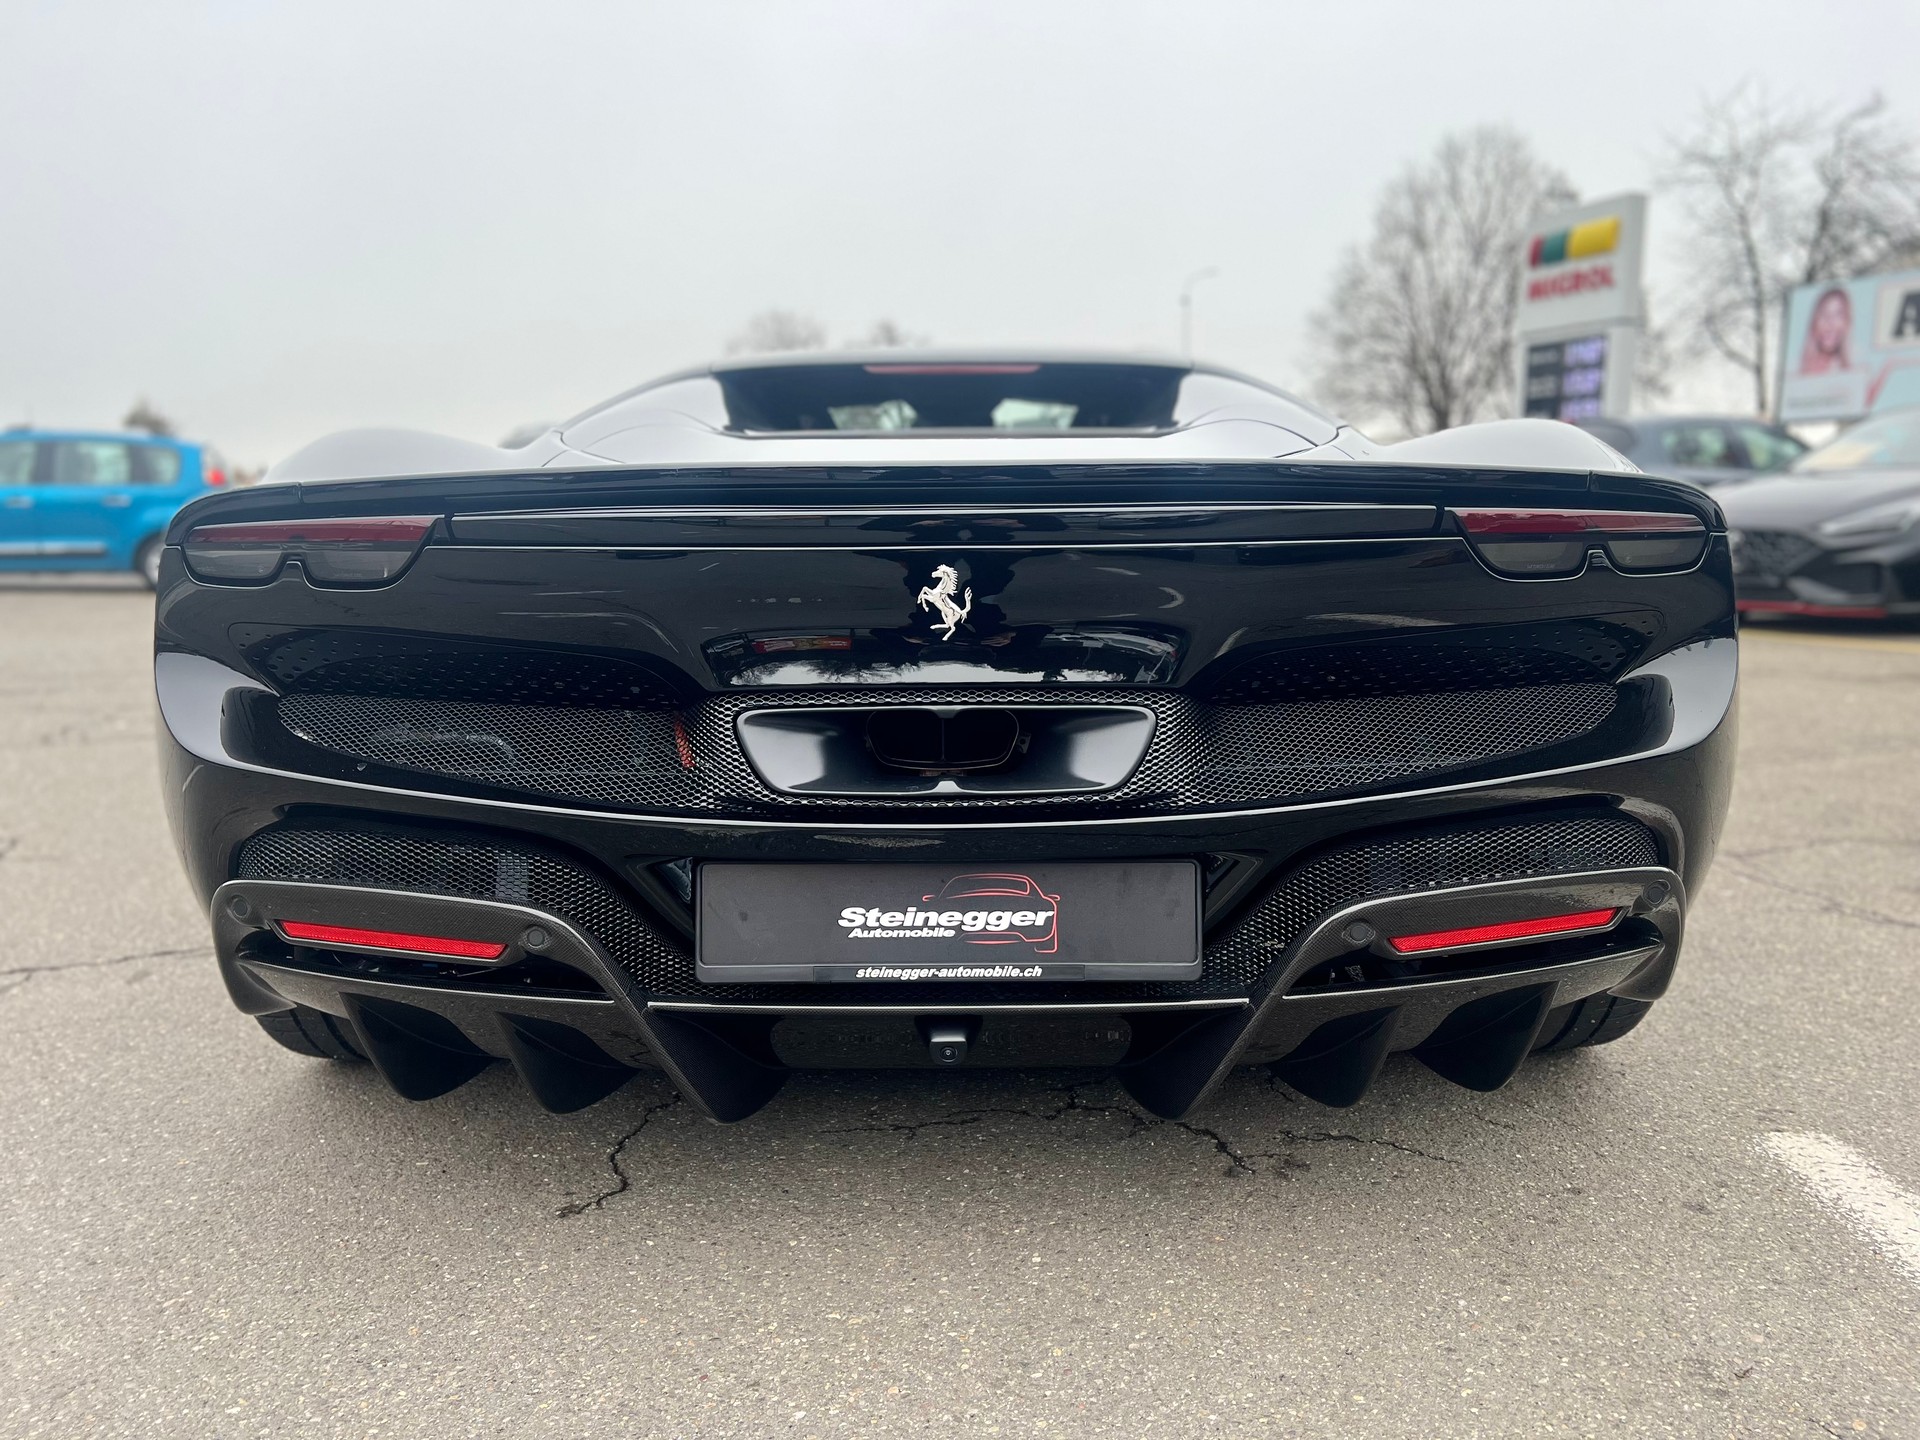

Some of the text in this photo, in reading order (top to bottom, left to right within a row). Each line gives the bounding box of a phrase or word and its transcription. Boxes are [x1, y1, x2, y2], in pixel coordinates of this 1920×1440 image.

[838, 907, 1054, 931] Steinegger
[848, 928, 955, 938] Automobile
[856, 966, 1043, 980] steinegger-automobile.ch
